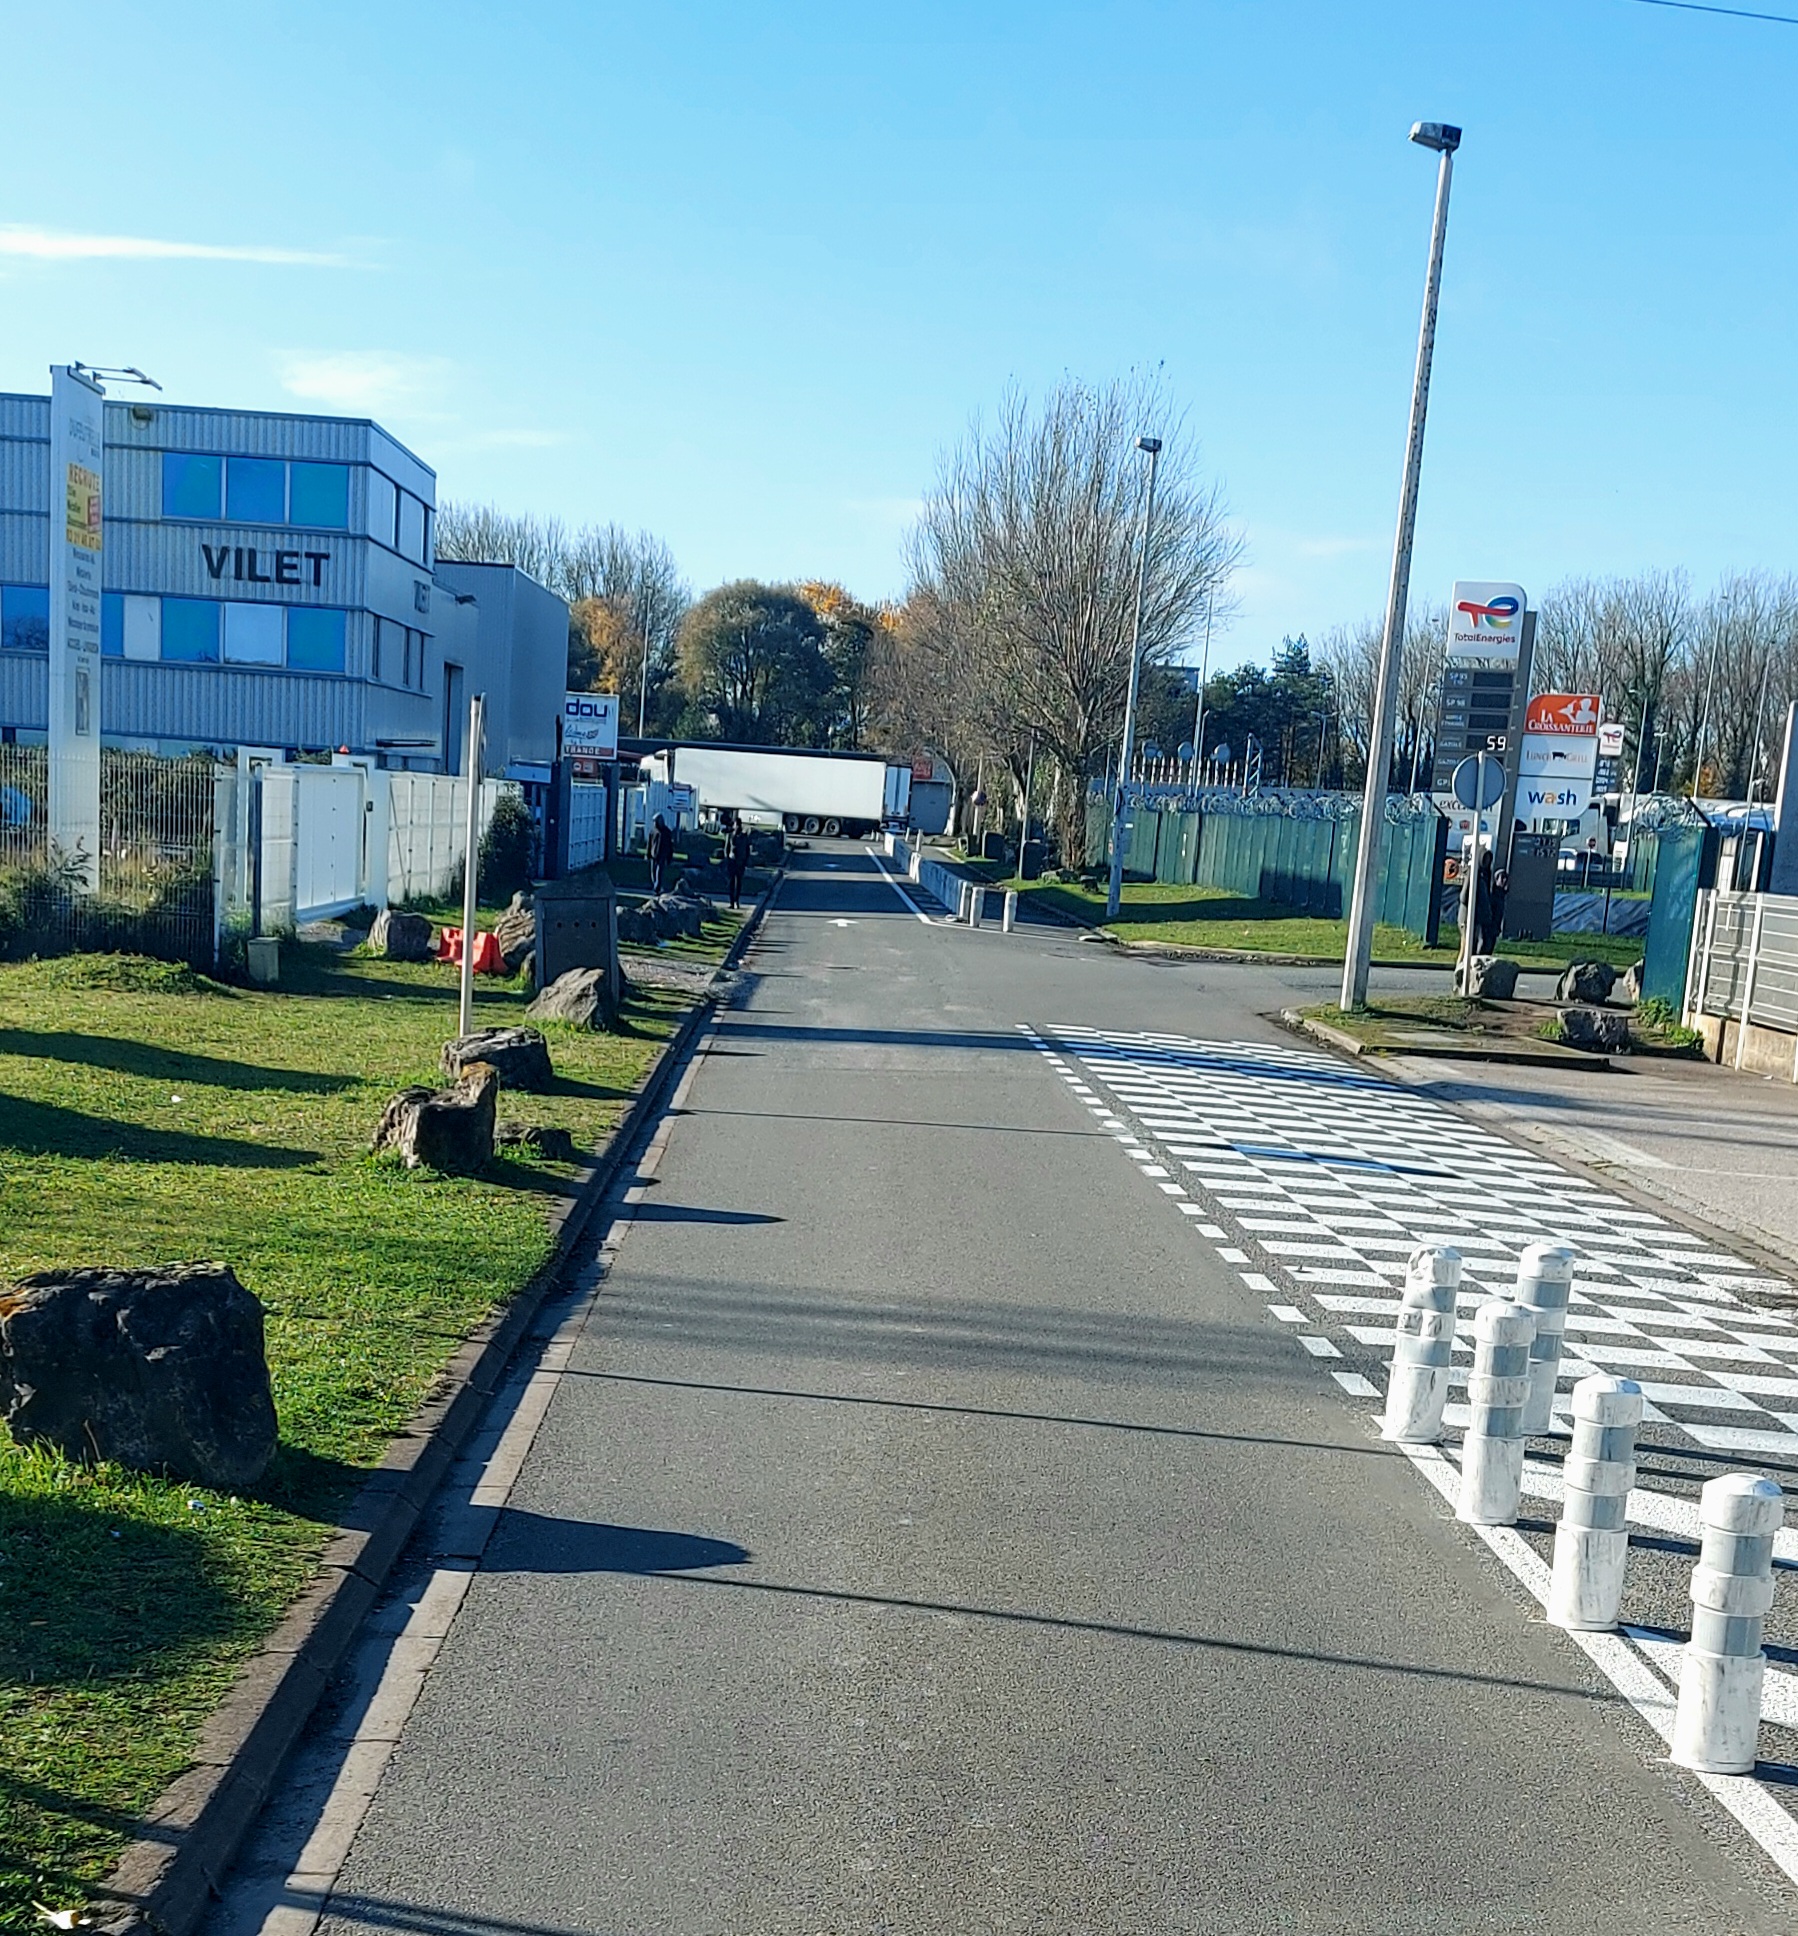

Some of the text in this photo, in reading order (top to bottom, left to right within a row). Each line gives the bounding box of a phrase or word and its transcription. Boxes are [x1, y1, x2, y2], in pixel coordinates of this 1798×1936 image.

[201, 543, 330, 587] VILET
[1454, 632, 1516, 645] TotalEnergies
[1540, 709, 1554, 722] LA
[1528, 719, 1594, 733] CROISSANTERIE
[1486, 735, 1507, 752] 59
[1528, 788, 1577, 806] wash
